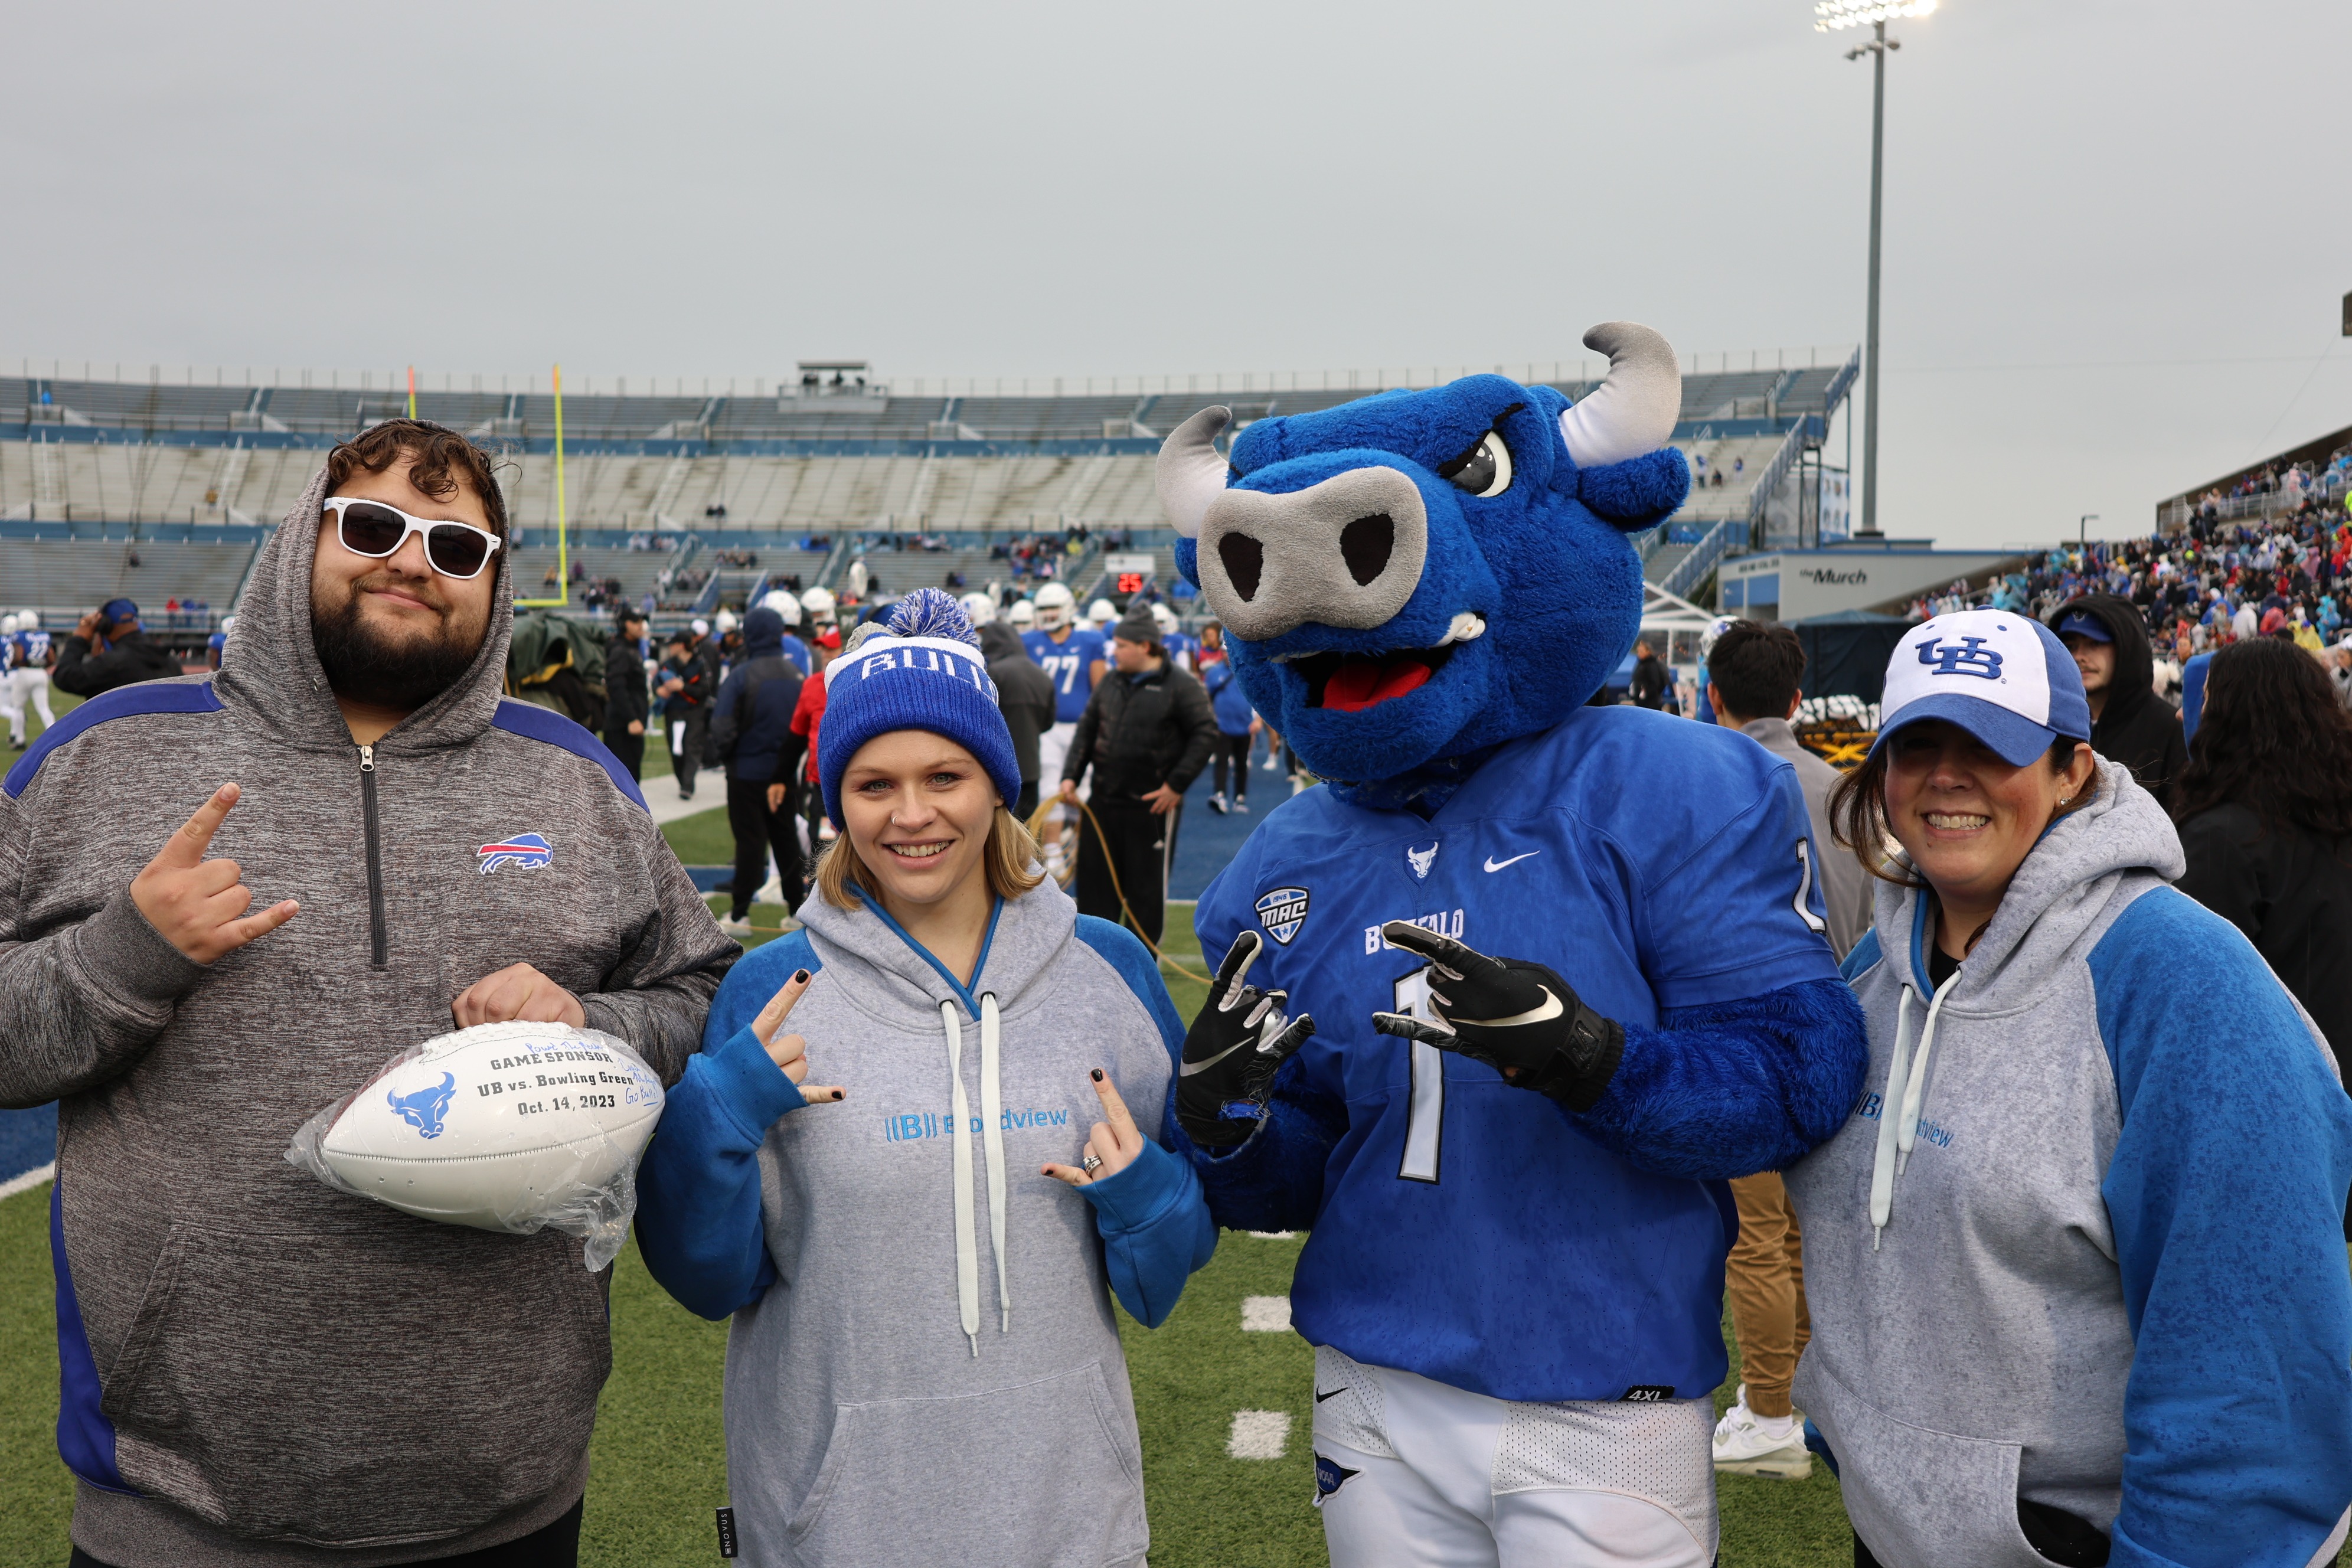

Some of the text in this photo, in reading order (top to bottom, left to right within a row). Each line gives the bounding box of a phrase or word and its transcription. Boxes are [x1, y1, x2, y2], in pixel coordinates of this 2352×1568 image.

[1118, 573, 1142, 592] 25
[1800, 568, 1867, 584] the Murch
[1915, 636, 2003, 680] UB
[1041, 655, 1080, 694] 77
[1273, 894, 1288, 903] 1946
[1260, 901, 1306, 927] MAC
[490, 1051, 613, 1070] GAME SPONSOR
[1393, 961, 1445, 1185] 1
[478, 1072, 634, 1097] UB vs. Bowling Green
[518, 1095, 615, 1115] Oct. 14, 2023
[626, 1087, 638, 1104] Go
[943, 1108, 1067, 1133] Bodview
[1628, 1390, 1663, 1401] 4XL
[1317, 1466, 1335, 1486] NCAA
[721, 1513, 731, 1547] NOVUS
